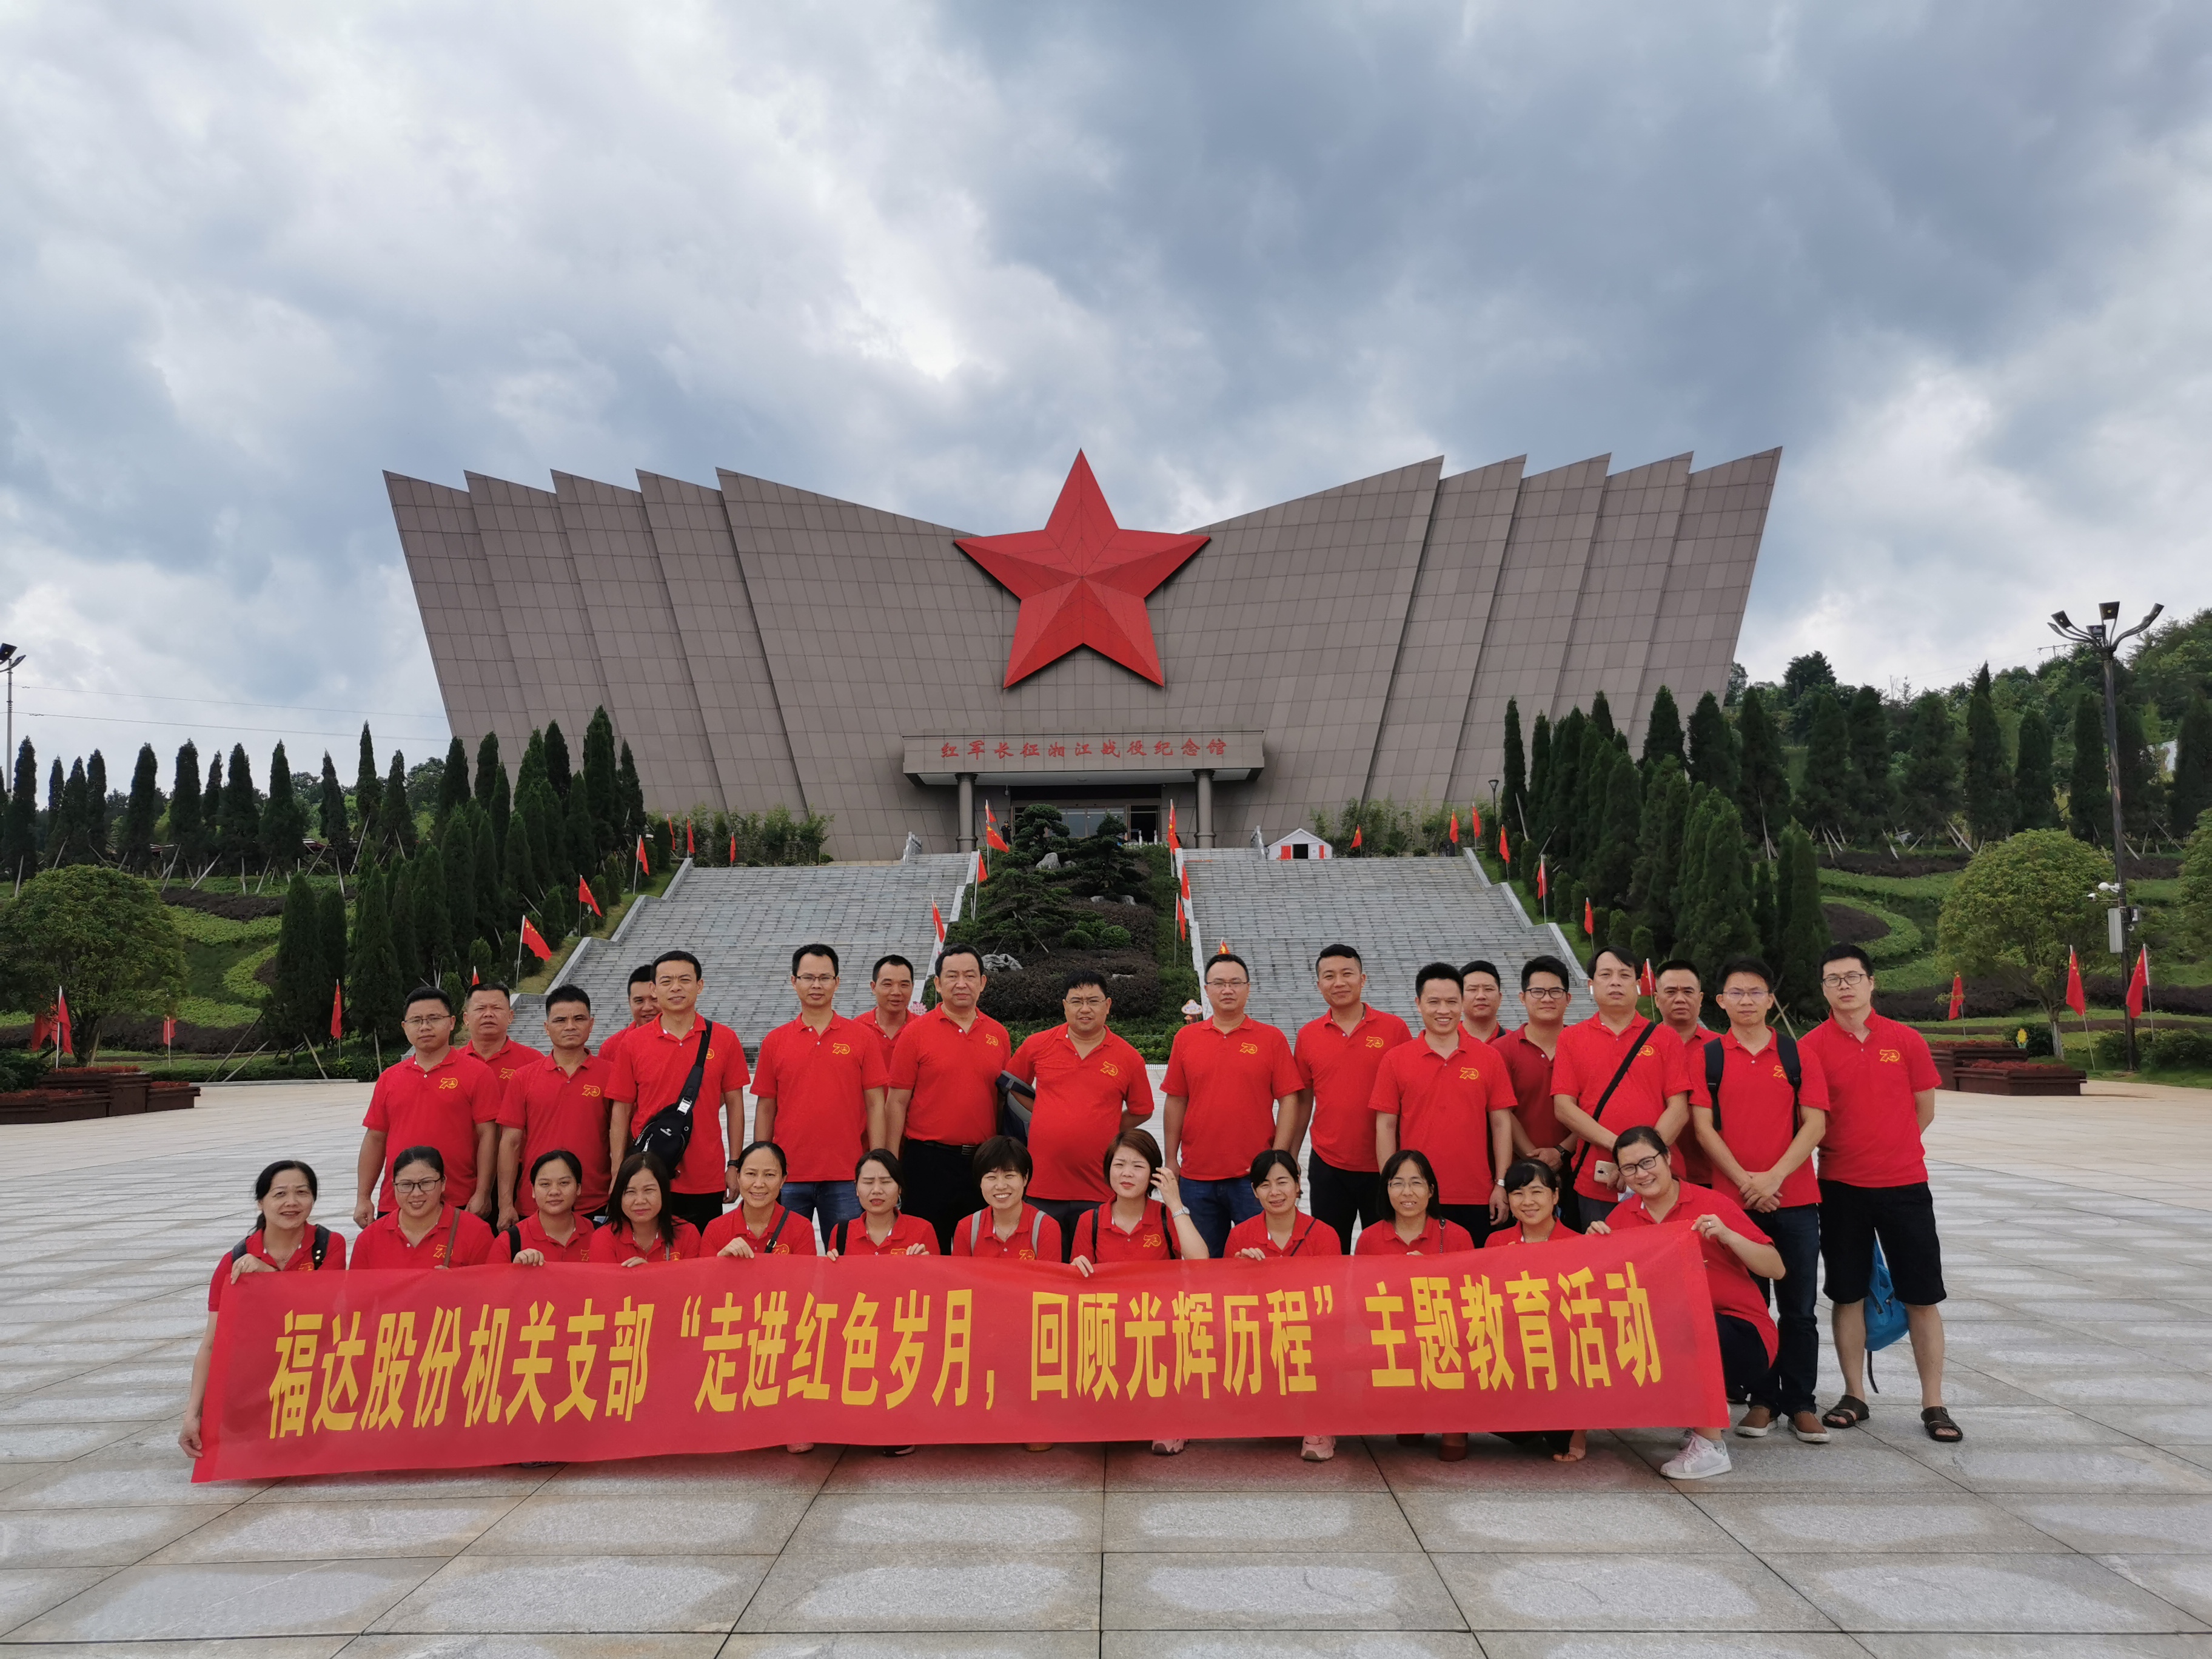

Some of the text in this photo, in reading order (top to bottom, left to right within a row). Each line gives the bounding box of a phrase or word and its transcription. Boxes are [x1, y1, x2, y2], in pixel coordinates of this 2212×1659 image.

[940, 737, 1227, 760] 红军长征湘江战役纪念馆
